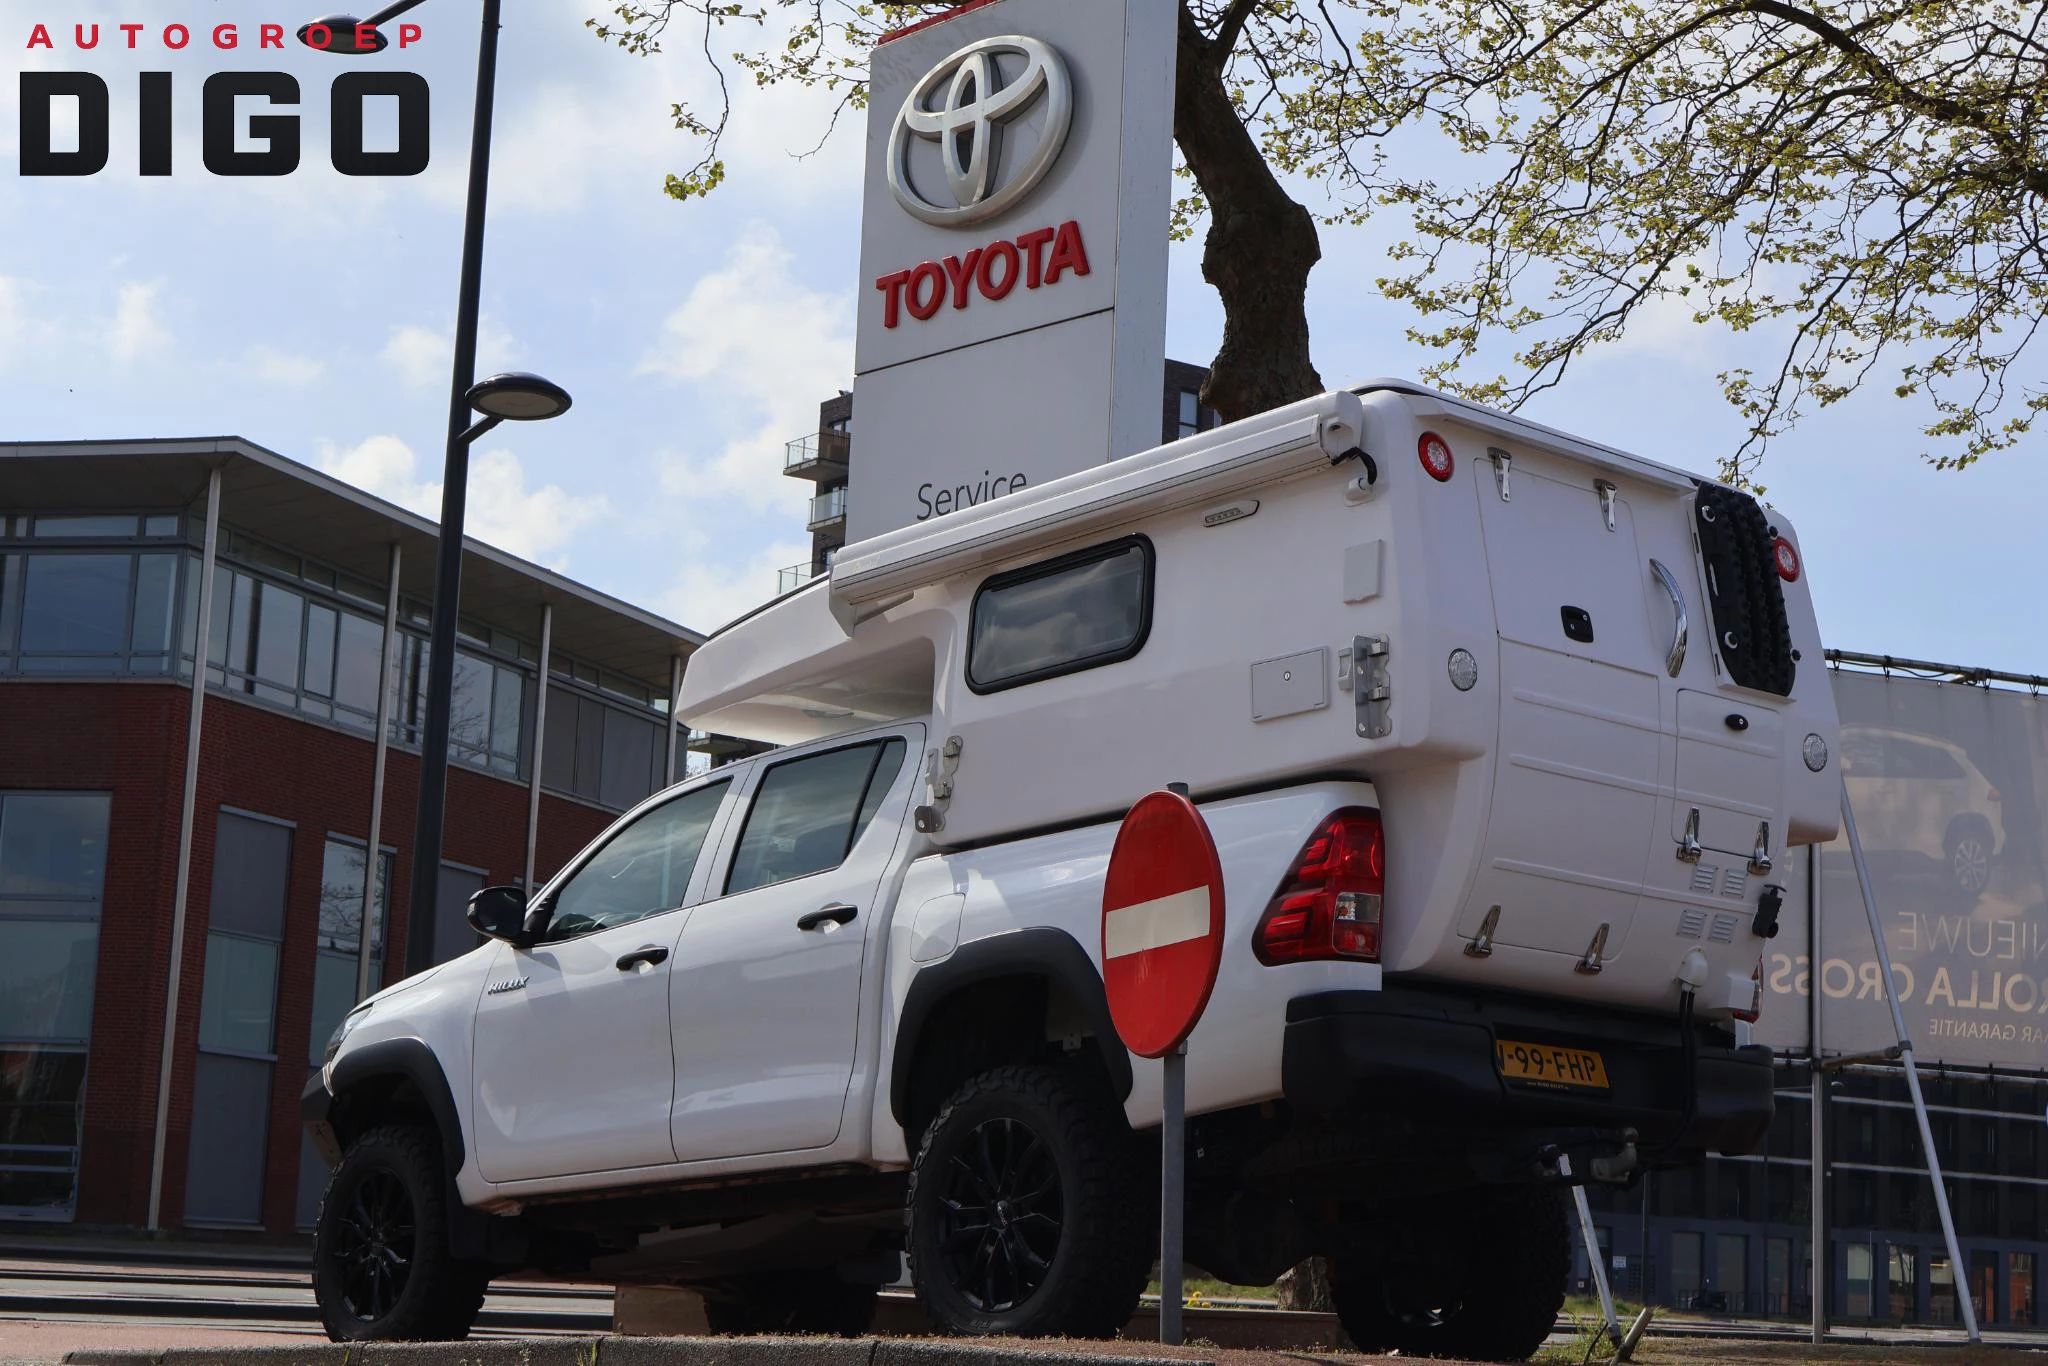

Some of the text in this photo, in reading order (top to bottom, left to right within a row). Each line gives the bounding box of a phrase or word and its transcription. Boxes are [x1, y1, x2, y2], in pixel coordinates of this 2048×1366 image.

[876, 221, 1090, 328] TOYOTA
[917, 470, 1027, 520] Service
[489, 977, 530, 994] HILUX
